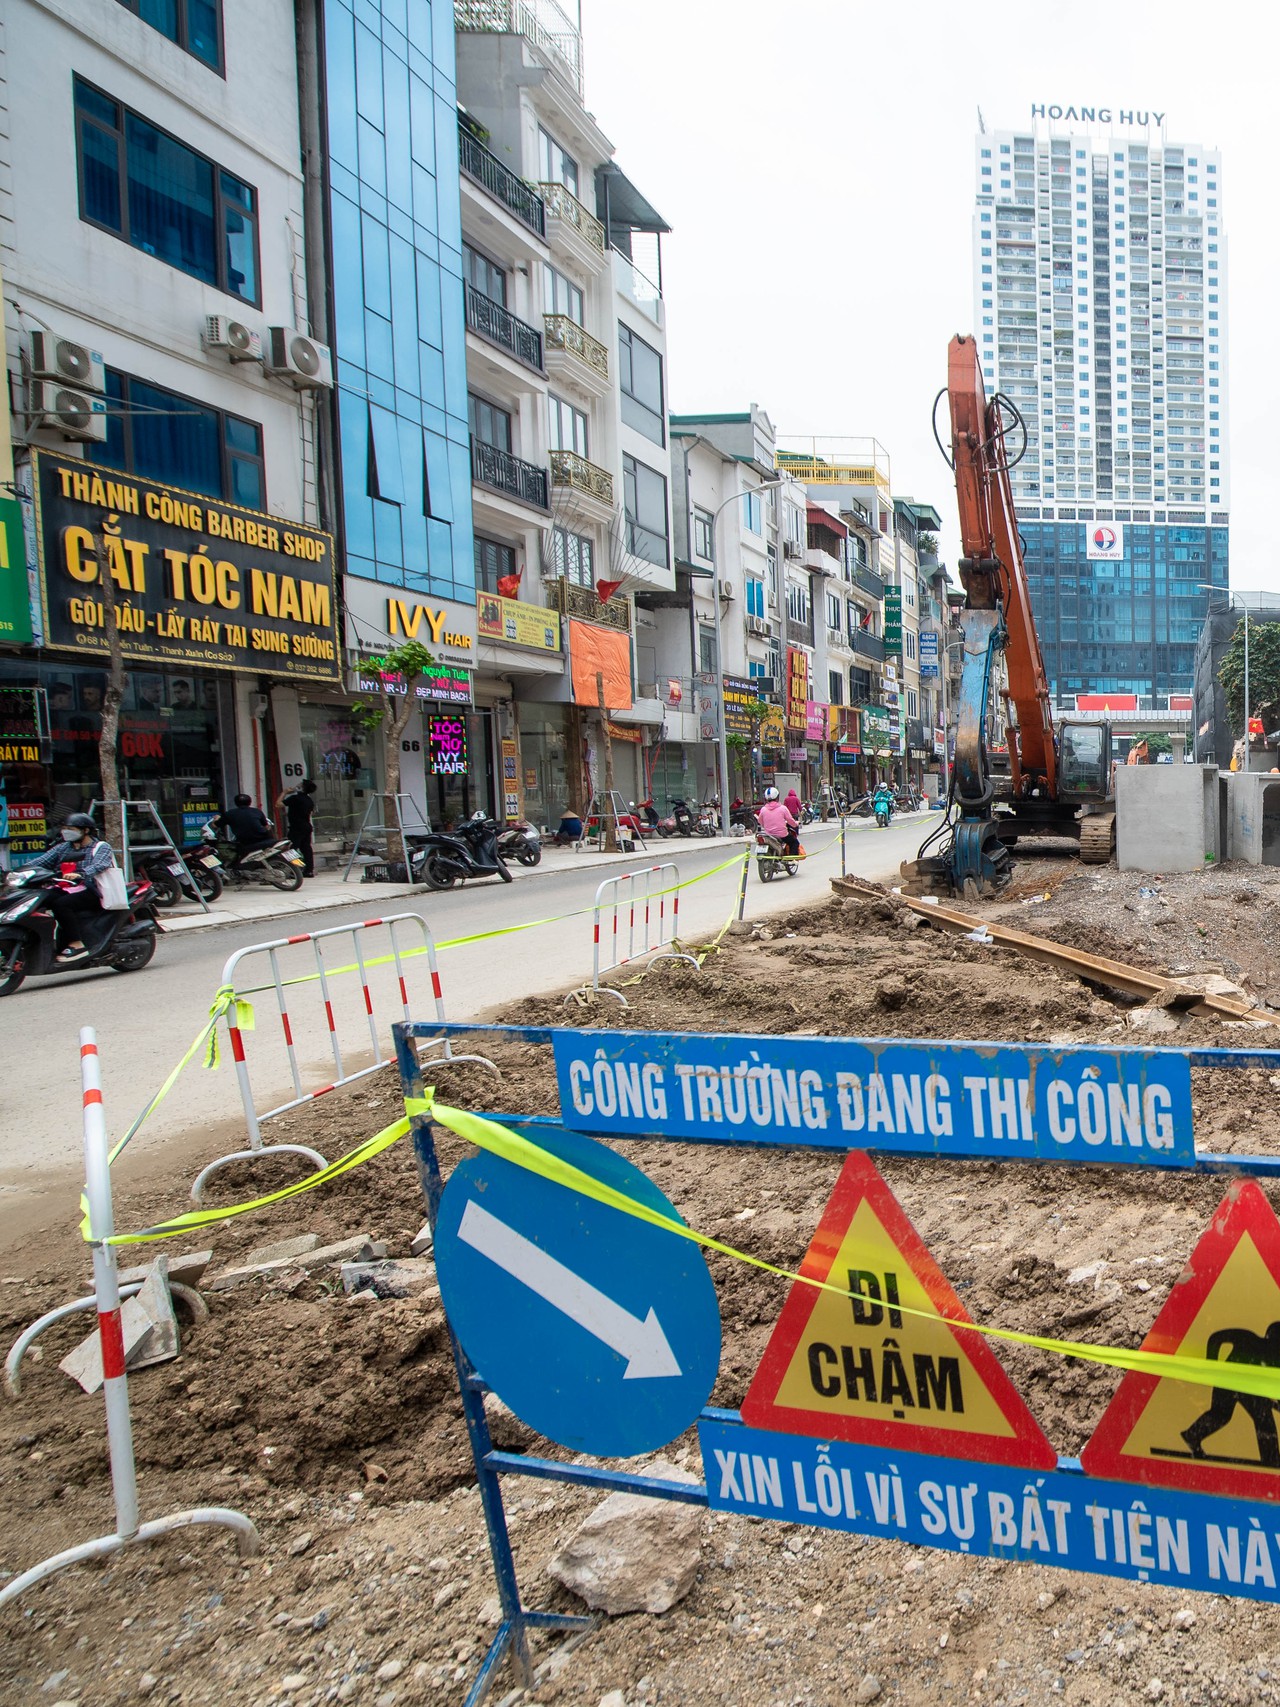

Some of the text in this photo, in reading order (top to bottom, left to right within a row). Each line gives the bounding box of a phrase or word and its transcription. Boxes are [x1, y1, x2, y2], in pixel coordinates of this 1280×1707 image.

[1031, 103, 1165, 127] HOANG HUY
[57, 467, 326, 562] THÀNH CÔNG BARBER SHOP
[65, 513, 149, 594] CẮT
[165, 544, 240, 610] TÓC
[251, 568, 331, 627] NAM
[69, 594, 104, 632] GỘI
[156, 607, 186, 639] LẤY
[190, 615, 219, 644] RÁY
[224, 623, 248, 648] TAI
[251, 628, 290, 654] SUNG
[292, 631, 335, 660] SƯỚNG
[387, 598, 447, 643] IVY
[444, 632, 472, 649] HAIR
[423, 665, 451, 679] Nguyễn
[21, 746, 39, 761] TAI
[121, 732, 165, 758] 60K
[402, 740, 420, 752] 66
[438, 751, 460, 762] IVY
[284, 763, 303, 777] 66
[433, 762, 465, 773] HAIR
[22, 805, 44, 817] TÓC
[29, 821, 44, 831] TÓC
[569, 1049, 1175, 1150] CÔNG TRƯỜNG ĐANG THI CÔNG
[848, 1269, 903, 1330] ĐI
[808, 1338, 965, 1419] CHẬM
[714, 1449, 784, 1508] XIN
[792, 1444, 857, 1520] LỖI
[865, 1464, 907, 1528] VÌ
[918, 1480, 978, 1552] SỰ
[987, 1478, 1071, 1555] BẤT
[1085, 1500, 1191, 1581] TIỆN
